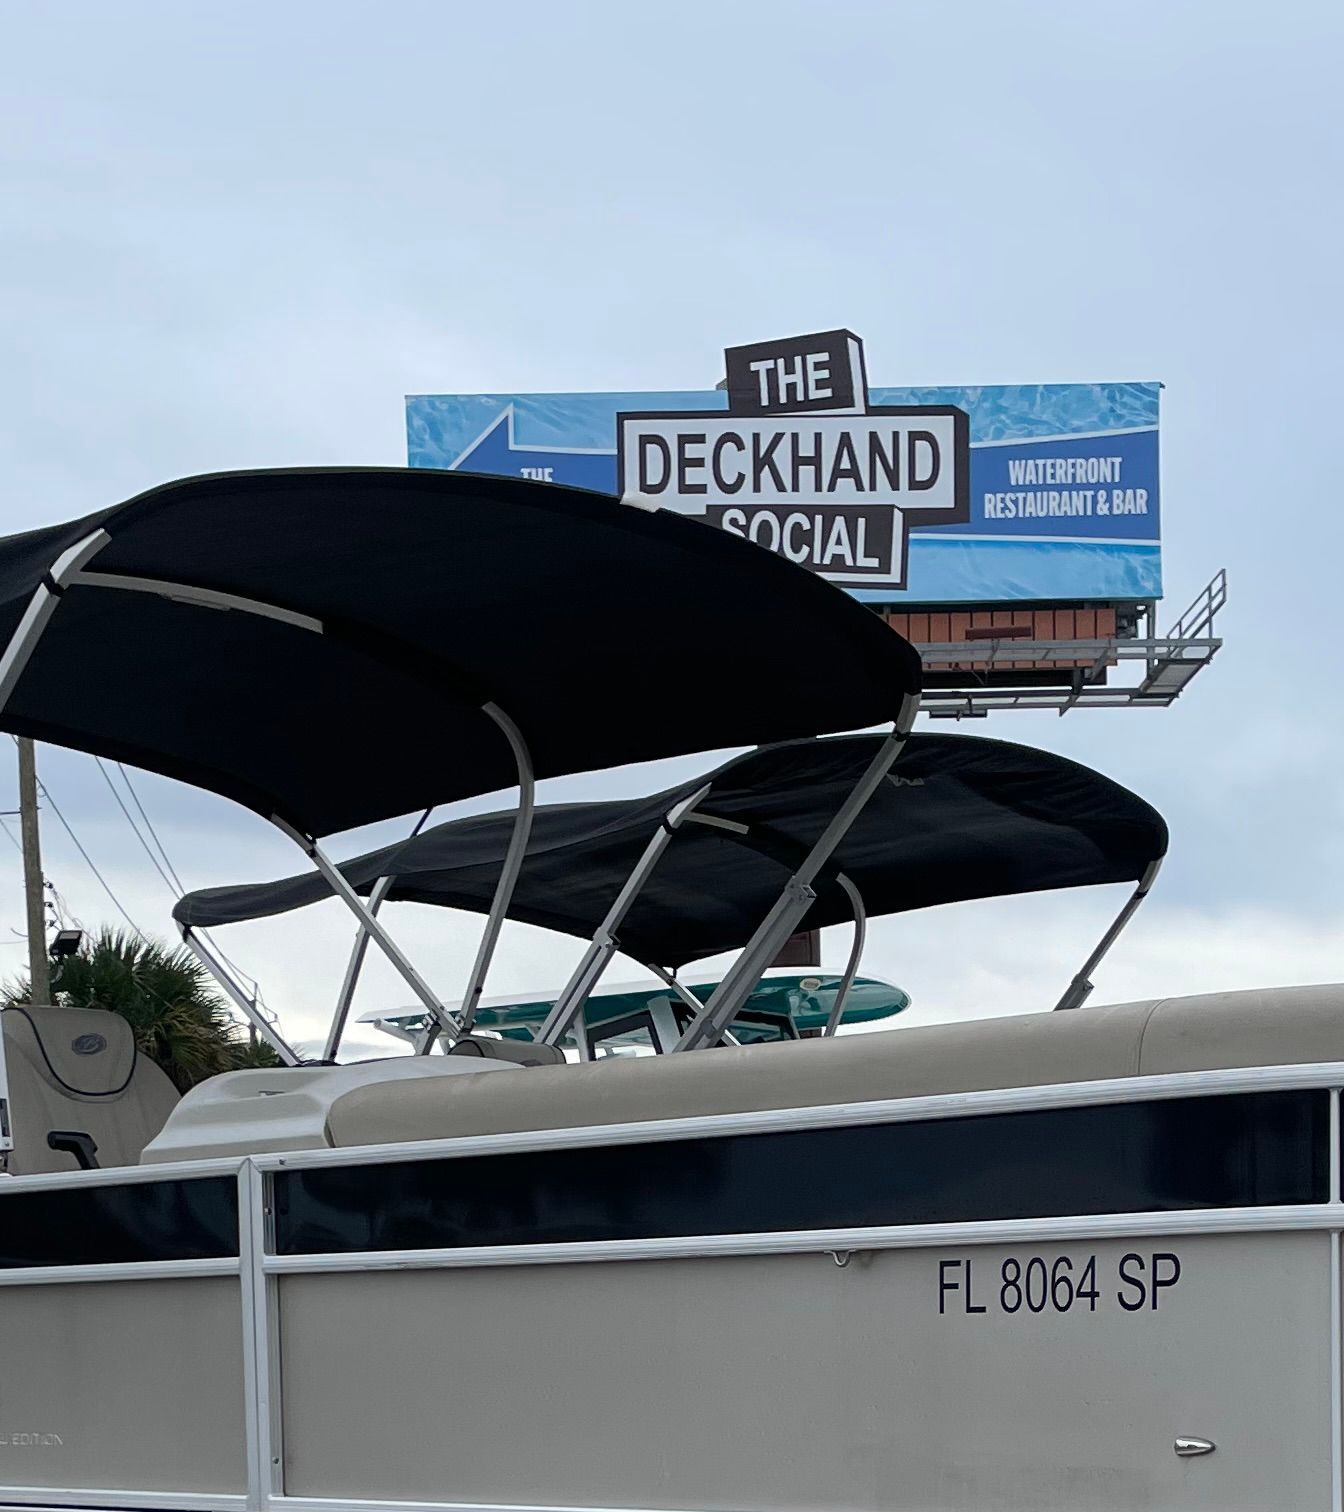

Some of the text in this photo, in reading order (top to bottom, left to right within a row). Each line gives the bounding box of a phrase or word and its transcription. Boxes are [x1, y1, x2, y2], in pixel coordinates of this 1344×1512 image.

[749, 351, 834, 407] THE
[638, 430, 941, 495] DECKHAND
[1008, 456, 1123, 486] WATERFRONT
[984, 488, 1148, 519] RESTAURANT & BAR
[938, 1252, 1181, 1314] FL 8064 SP
[12, 1432, 64, 1446] EDITION
